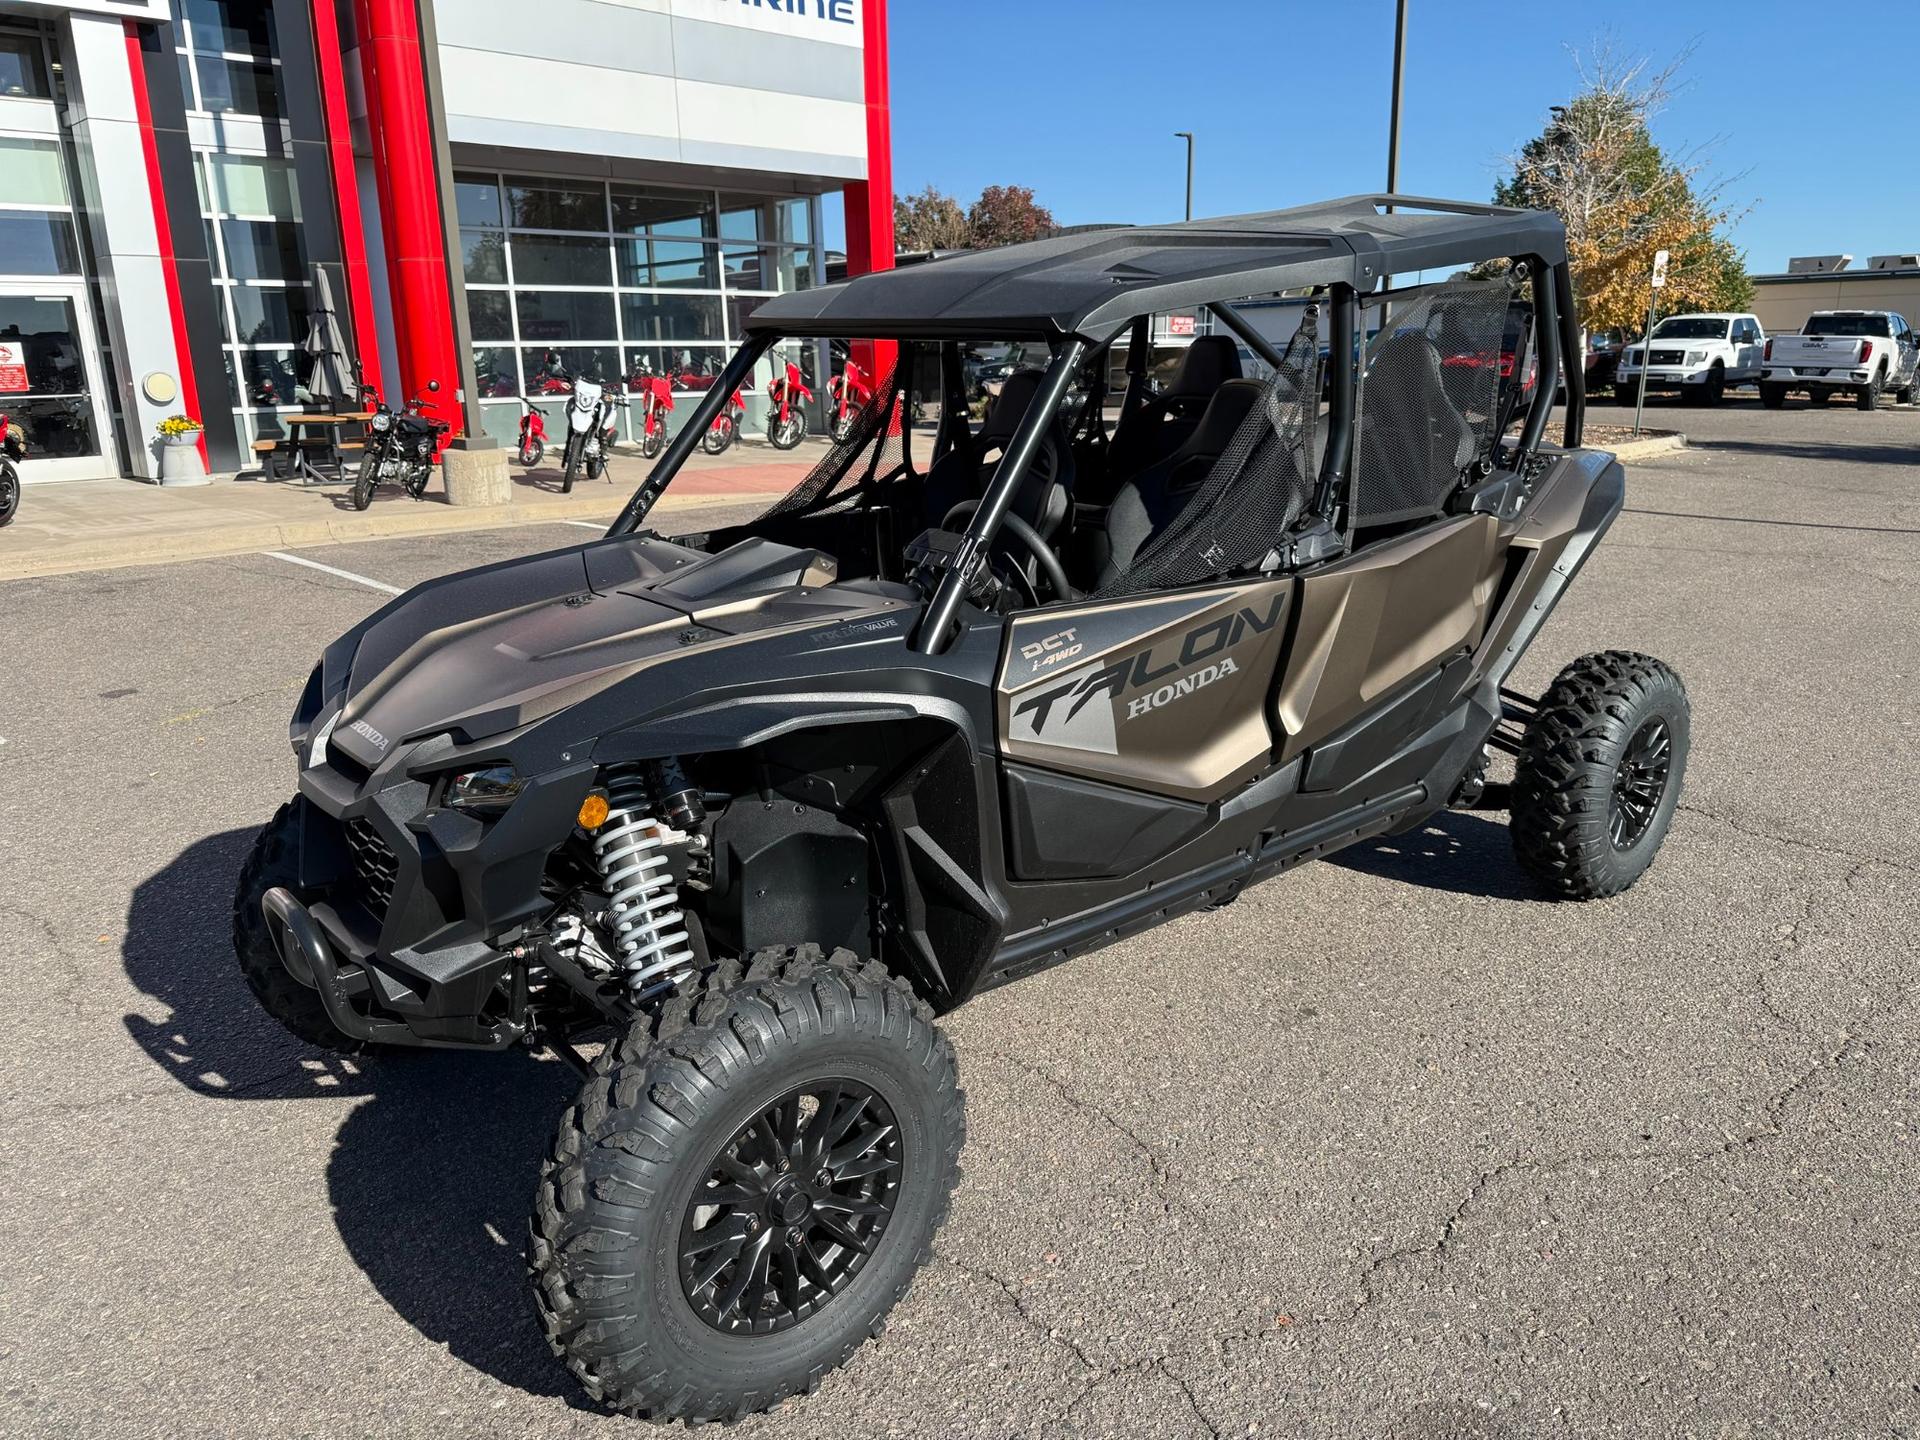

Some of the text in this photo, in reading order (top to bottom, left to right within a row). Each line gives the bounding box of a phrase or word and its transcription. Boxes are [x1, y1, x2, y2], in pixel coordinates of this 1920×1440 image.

[864, 618, 898, 631] VALVE
[1020, 627, 1077, 660] DCT
[1012, 591, 1286, 736] TALON
[1127, 657, 1239, 720] HONDA
[350, 719, 389, 751] HONDA
